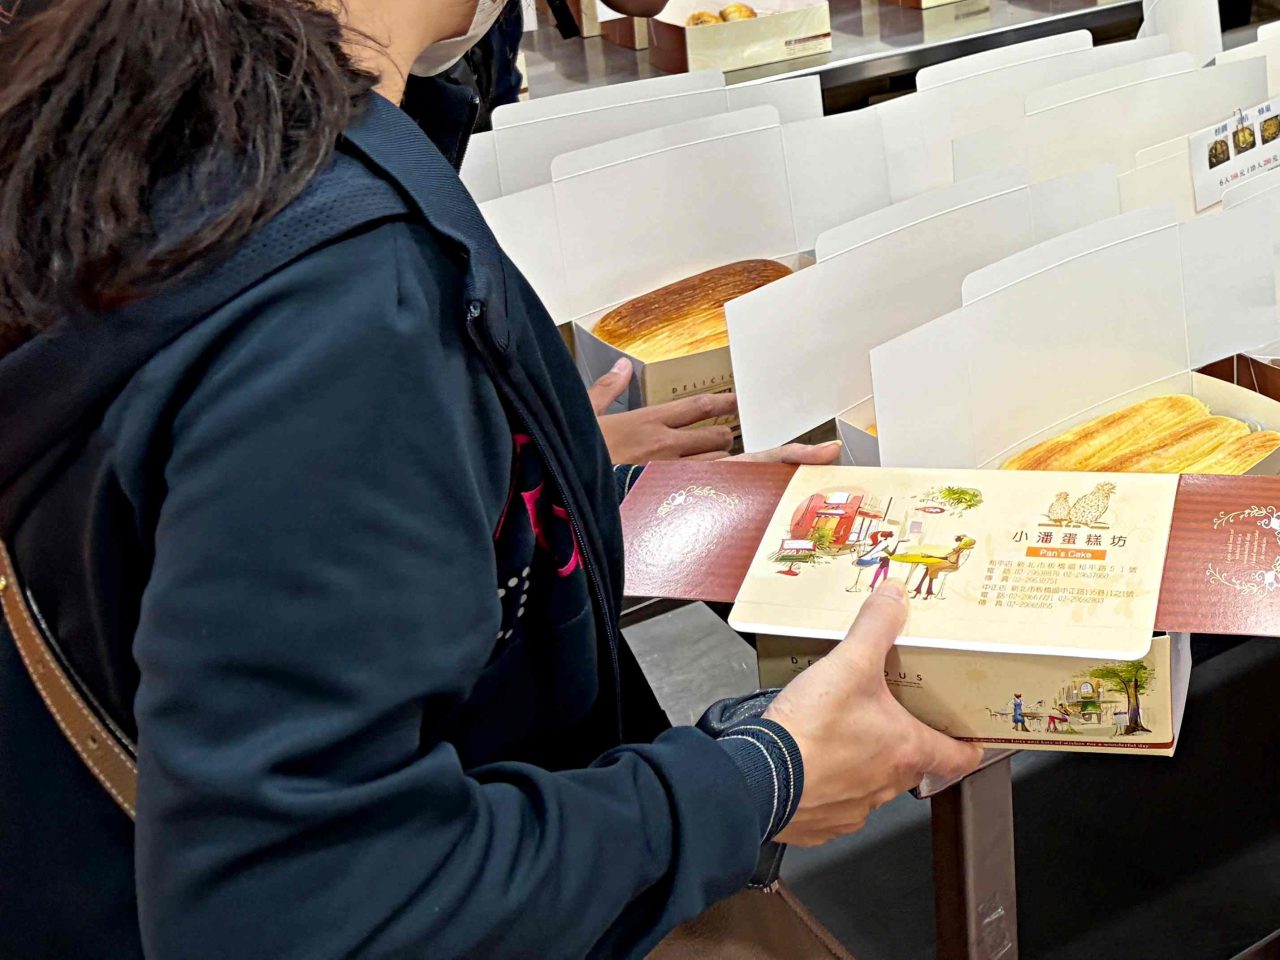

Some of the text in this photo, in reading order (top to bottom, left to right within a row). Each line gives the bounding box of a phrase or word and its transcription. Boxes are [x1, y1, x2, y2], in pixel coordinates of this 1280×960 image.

[1012, 530, 1128, 548] 小潘蛋糕坊
[1039, 548, 1093, 559] Pan's Cake
